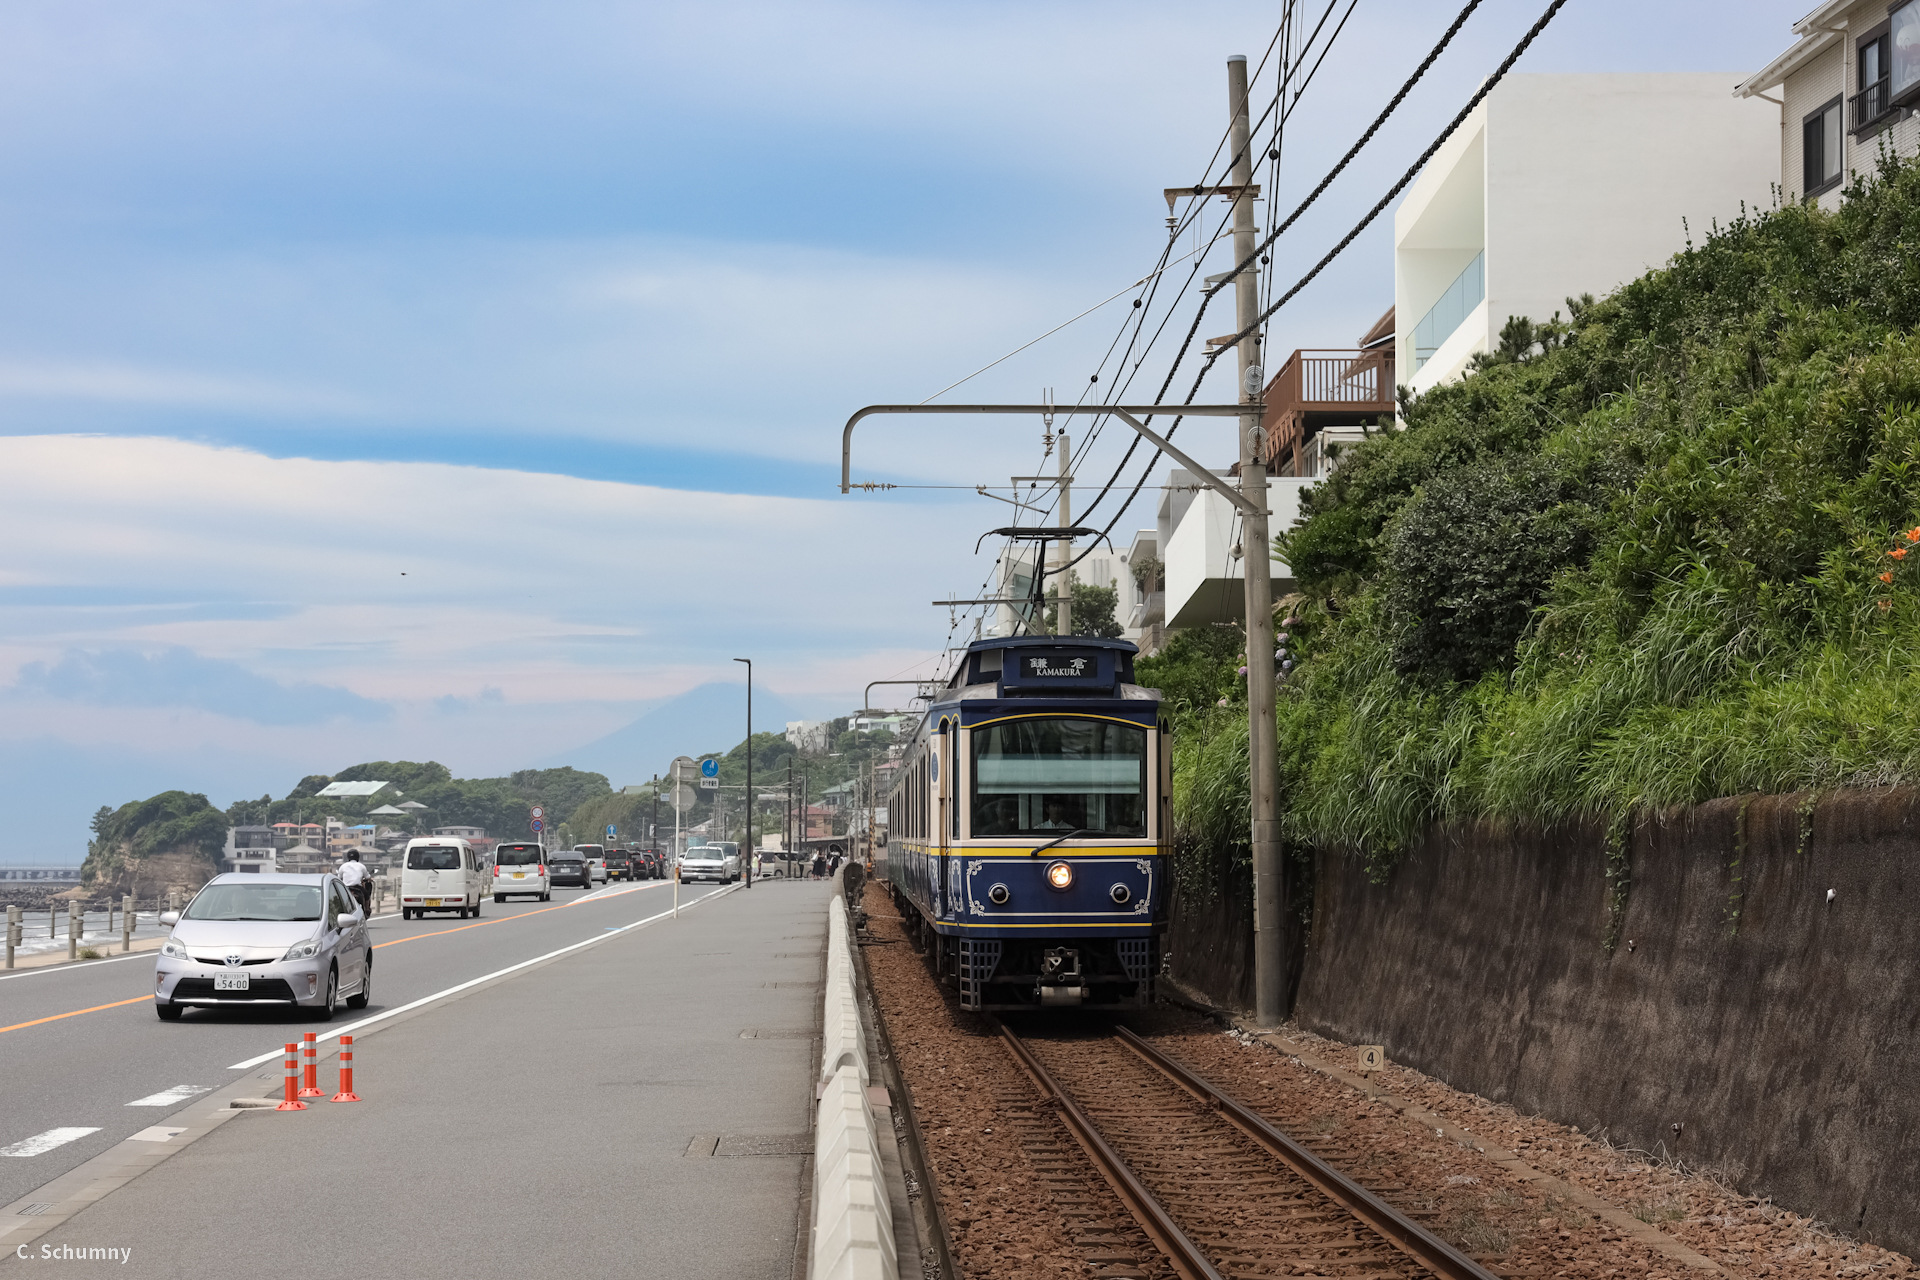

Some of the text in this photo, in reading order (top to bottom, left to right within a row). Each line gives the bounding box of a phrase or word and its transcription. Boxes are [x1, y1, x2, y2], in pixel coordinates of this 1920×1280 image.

[1029, 657, 1088, 669] 鎌倉
[1036, 668, 1081, 676] KAMAKURA
[222, 980, 247, 989] 54-00
[1367, 1052, 1374, 1064] 4
